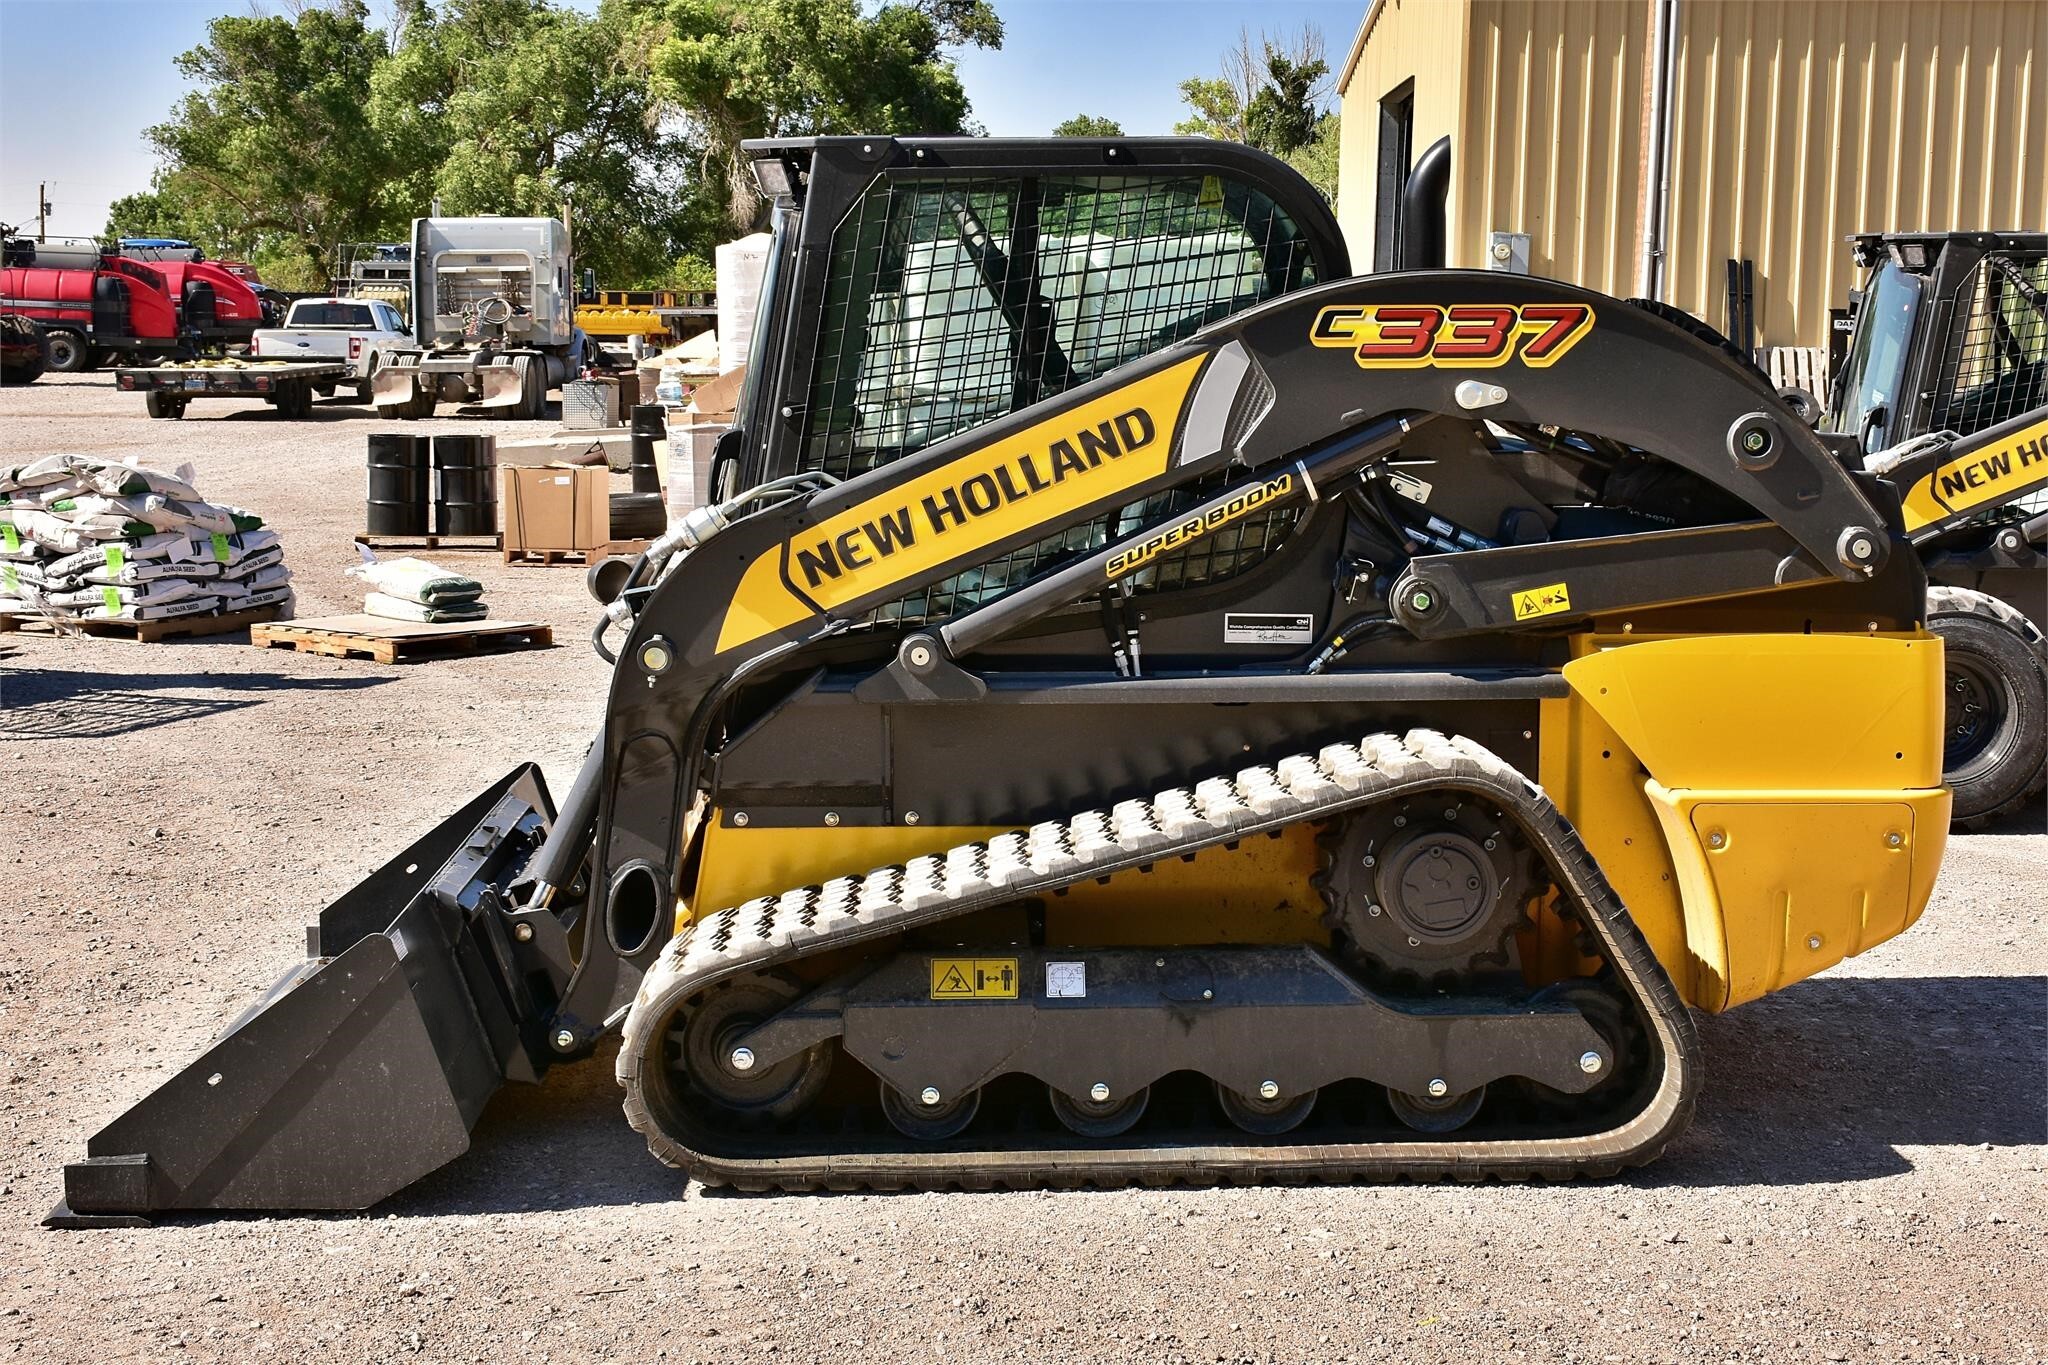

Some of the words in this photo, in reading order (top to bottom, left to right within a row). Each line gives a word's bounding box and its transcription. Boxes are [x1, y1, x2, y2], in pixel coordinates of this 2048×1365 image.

[1309, 303, 1597, 369] C337
[1940, 450, 2012, 499] NEW
[795, 505, 917, 588] NEW
[920, 407, 1156, 535] HOLLAND
[1106, 517, 1203, 577] SUPER
[1205, 474, 1291, 530] BOOM
[67, 556, 88, 569] ALFALFA
[88, 552, 104, 560] SEED
[163, 564, 182, 573] ALFALFA
[183, 564, 195, 572] SEED
[242, 560, 258, 571] ALFALFA
[258, 556, 270, 566] SEED
[246, 596, 262, 605] ALFALFA
[262, 593, 274, 602] SEED
[166, 605, 185, 614] ALFALFA
[186, 603, 200, 612] SEED
